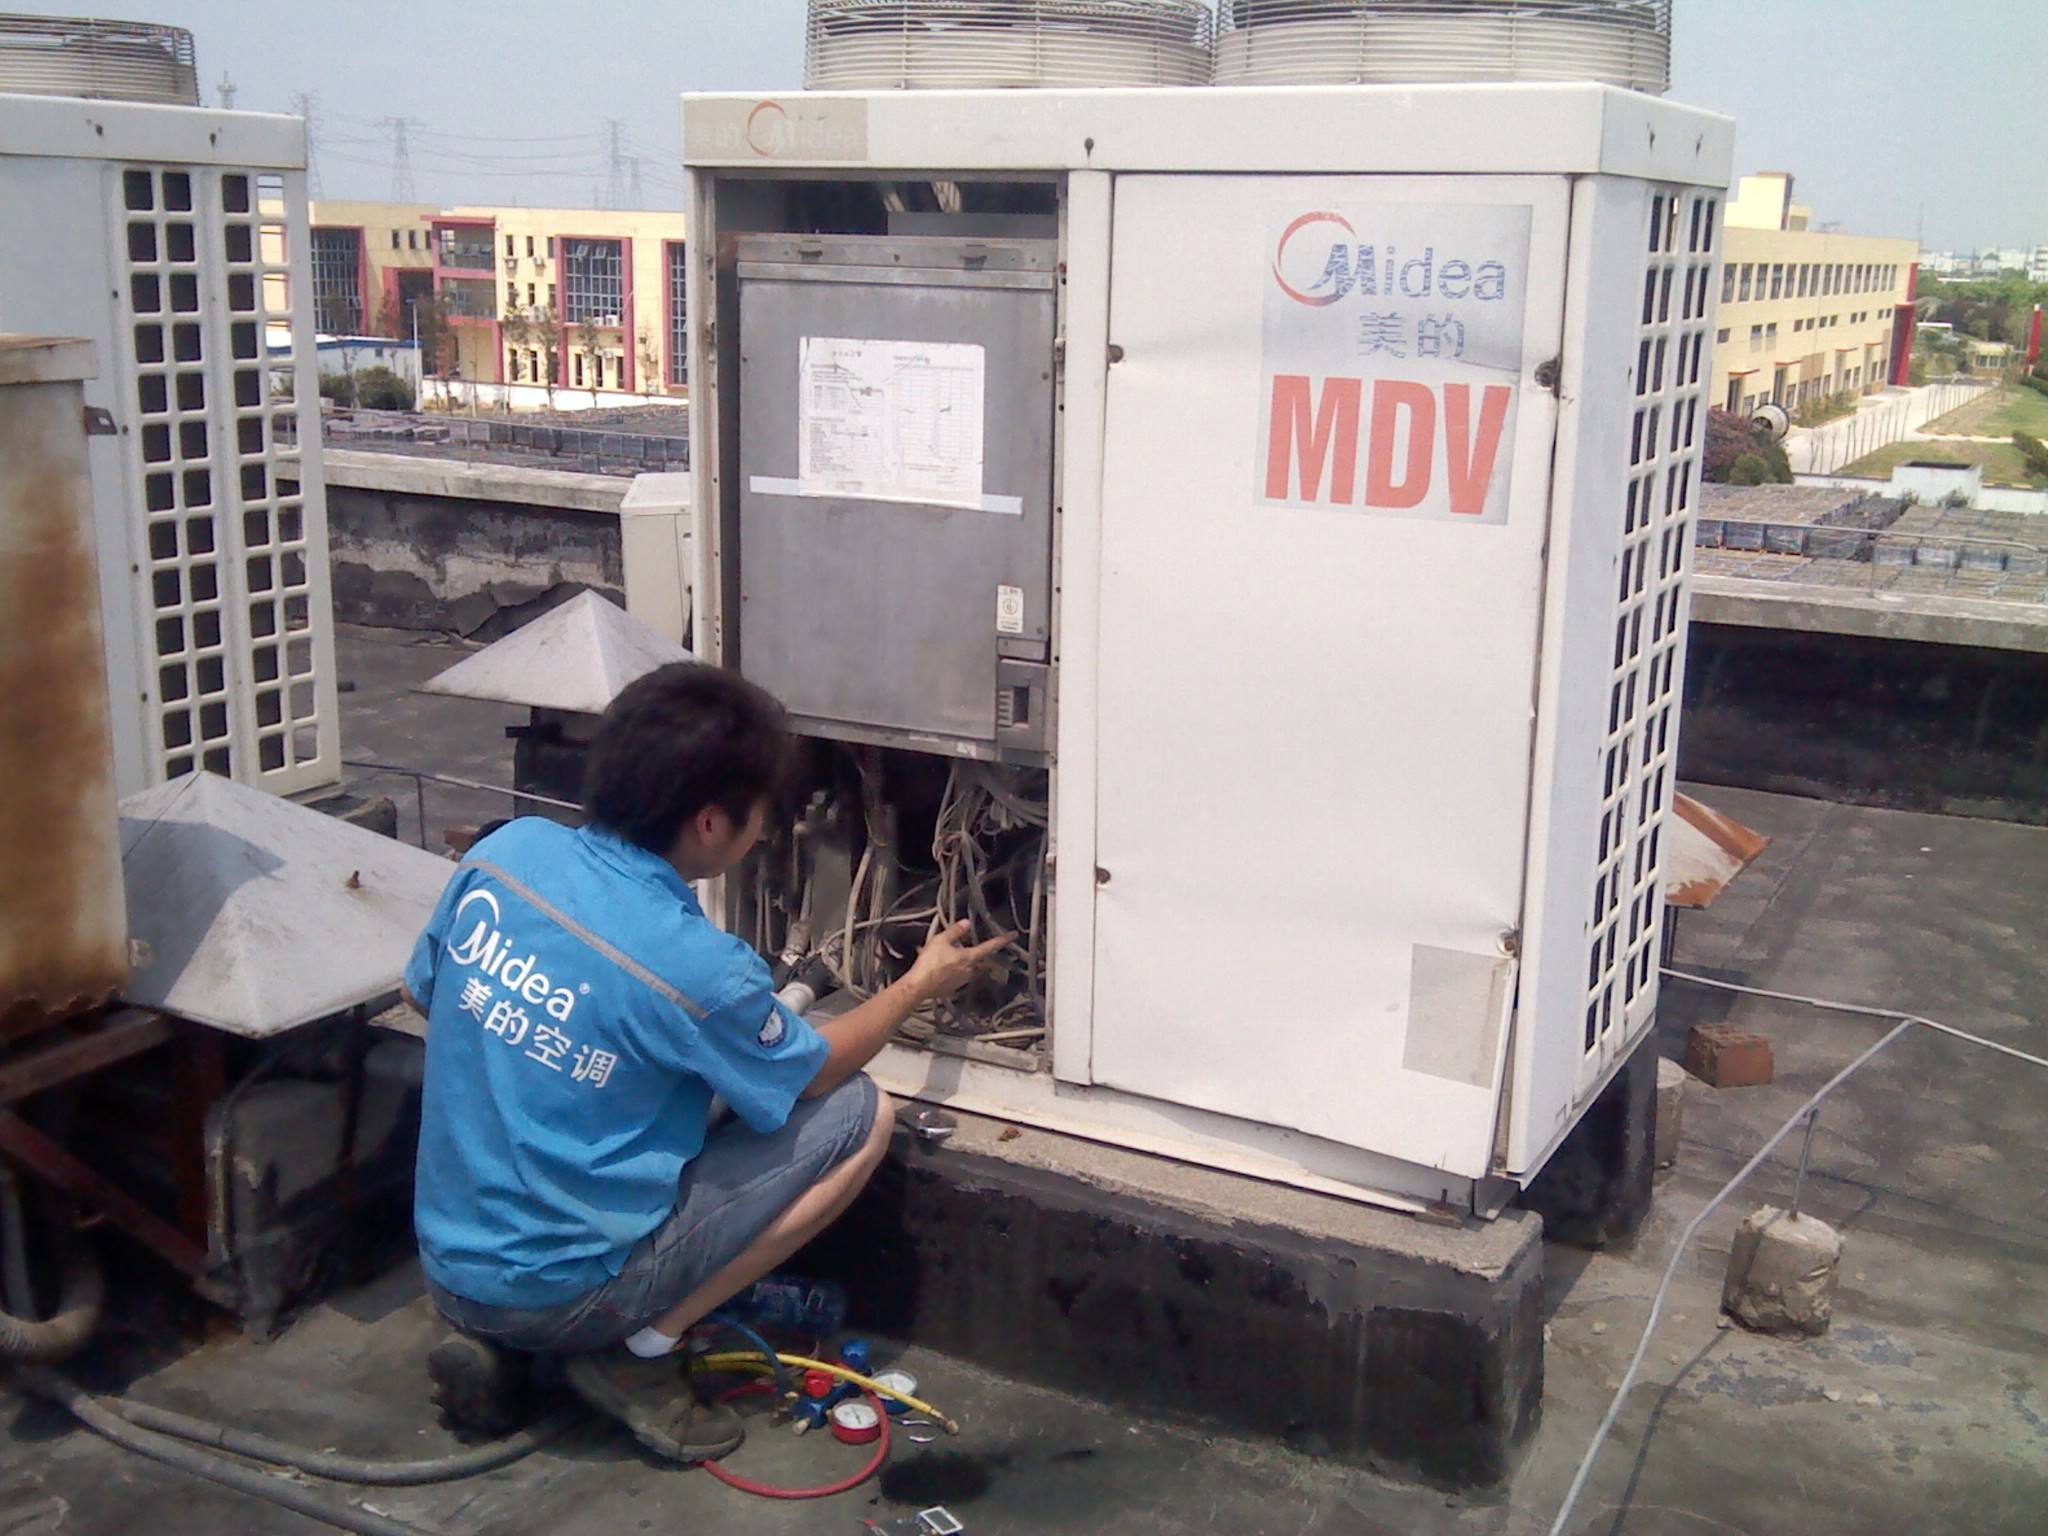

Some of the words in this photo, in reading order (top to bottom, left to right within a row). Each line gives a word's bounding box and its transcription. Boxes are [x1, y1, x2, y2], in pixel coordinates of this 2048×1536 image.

[1305, 243, 1506, 302] Midea
[1357, 311, 1465, 359] 美的
[1265, 374, 1512, 515] MDV
[457, 919, 576, 1022] Midea
[457, 976, 618, 1089] 美的空调
